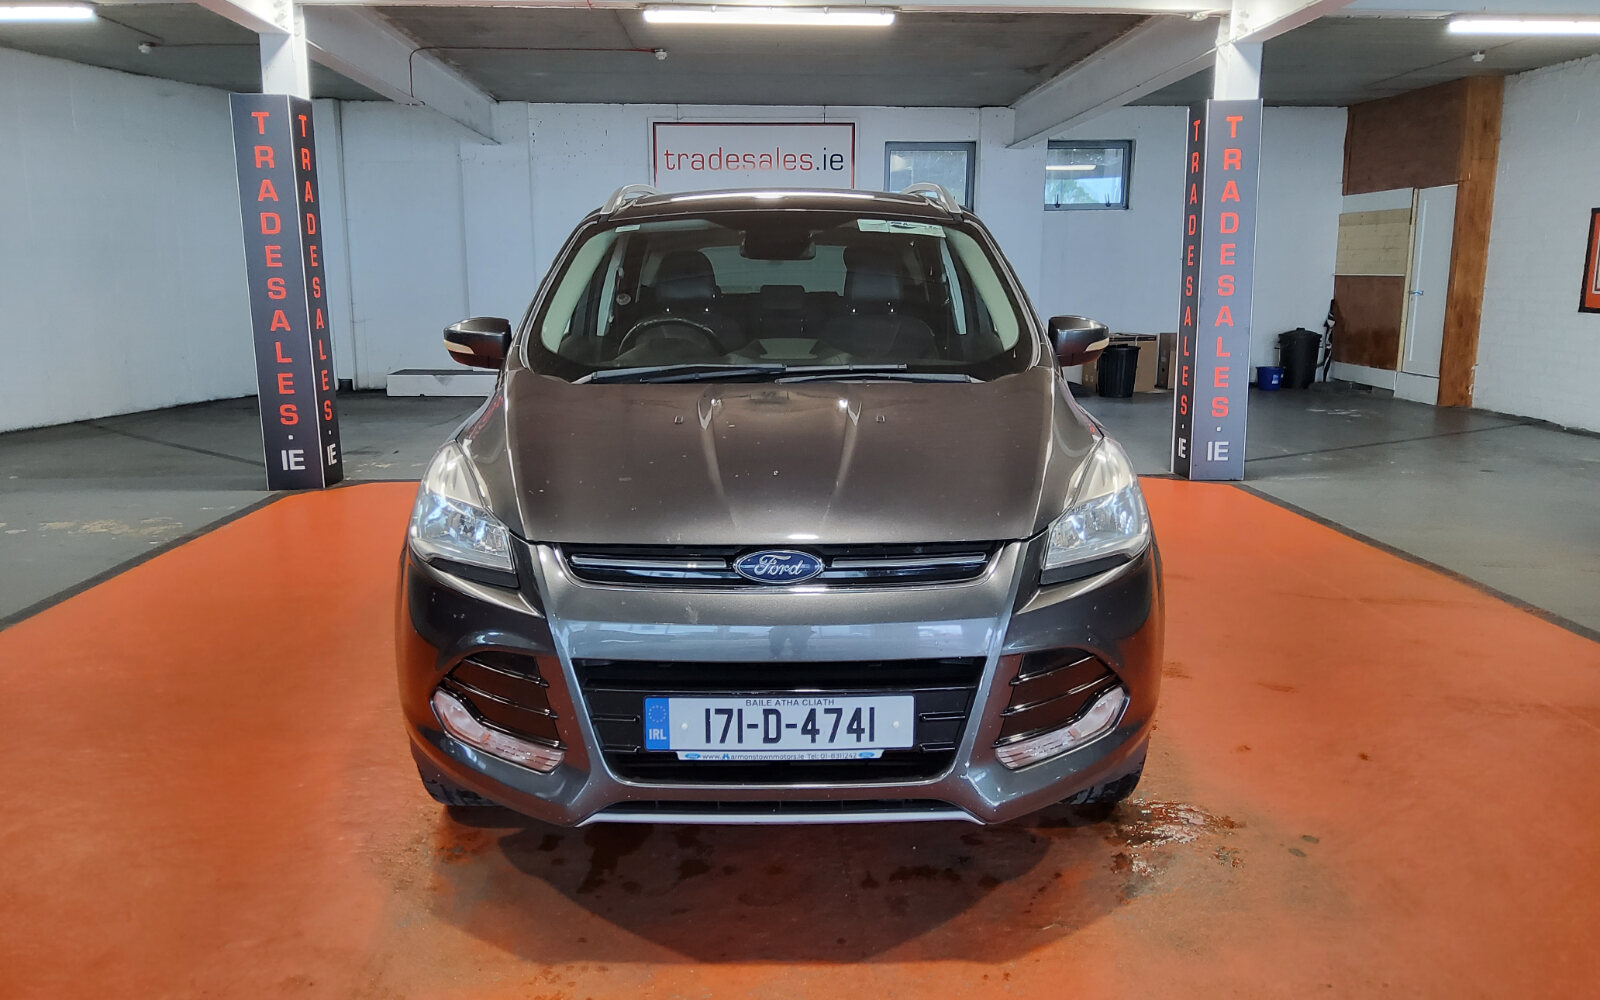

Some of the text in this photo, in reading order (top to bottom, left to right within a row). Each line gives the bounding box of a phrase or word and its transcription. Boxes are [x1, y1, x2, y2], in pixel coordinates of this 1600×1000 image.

[664, 147, 844, 171] tradesales.ie
[754, 554, 803, 576] Ford
[745, 699, 772, 707] BAILE
[801, 698, 835, 706] CLIATH
[648, 728, 667, 740] IRL
[705, 706, 875, 744] 171-D-4741
